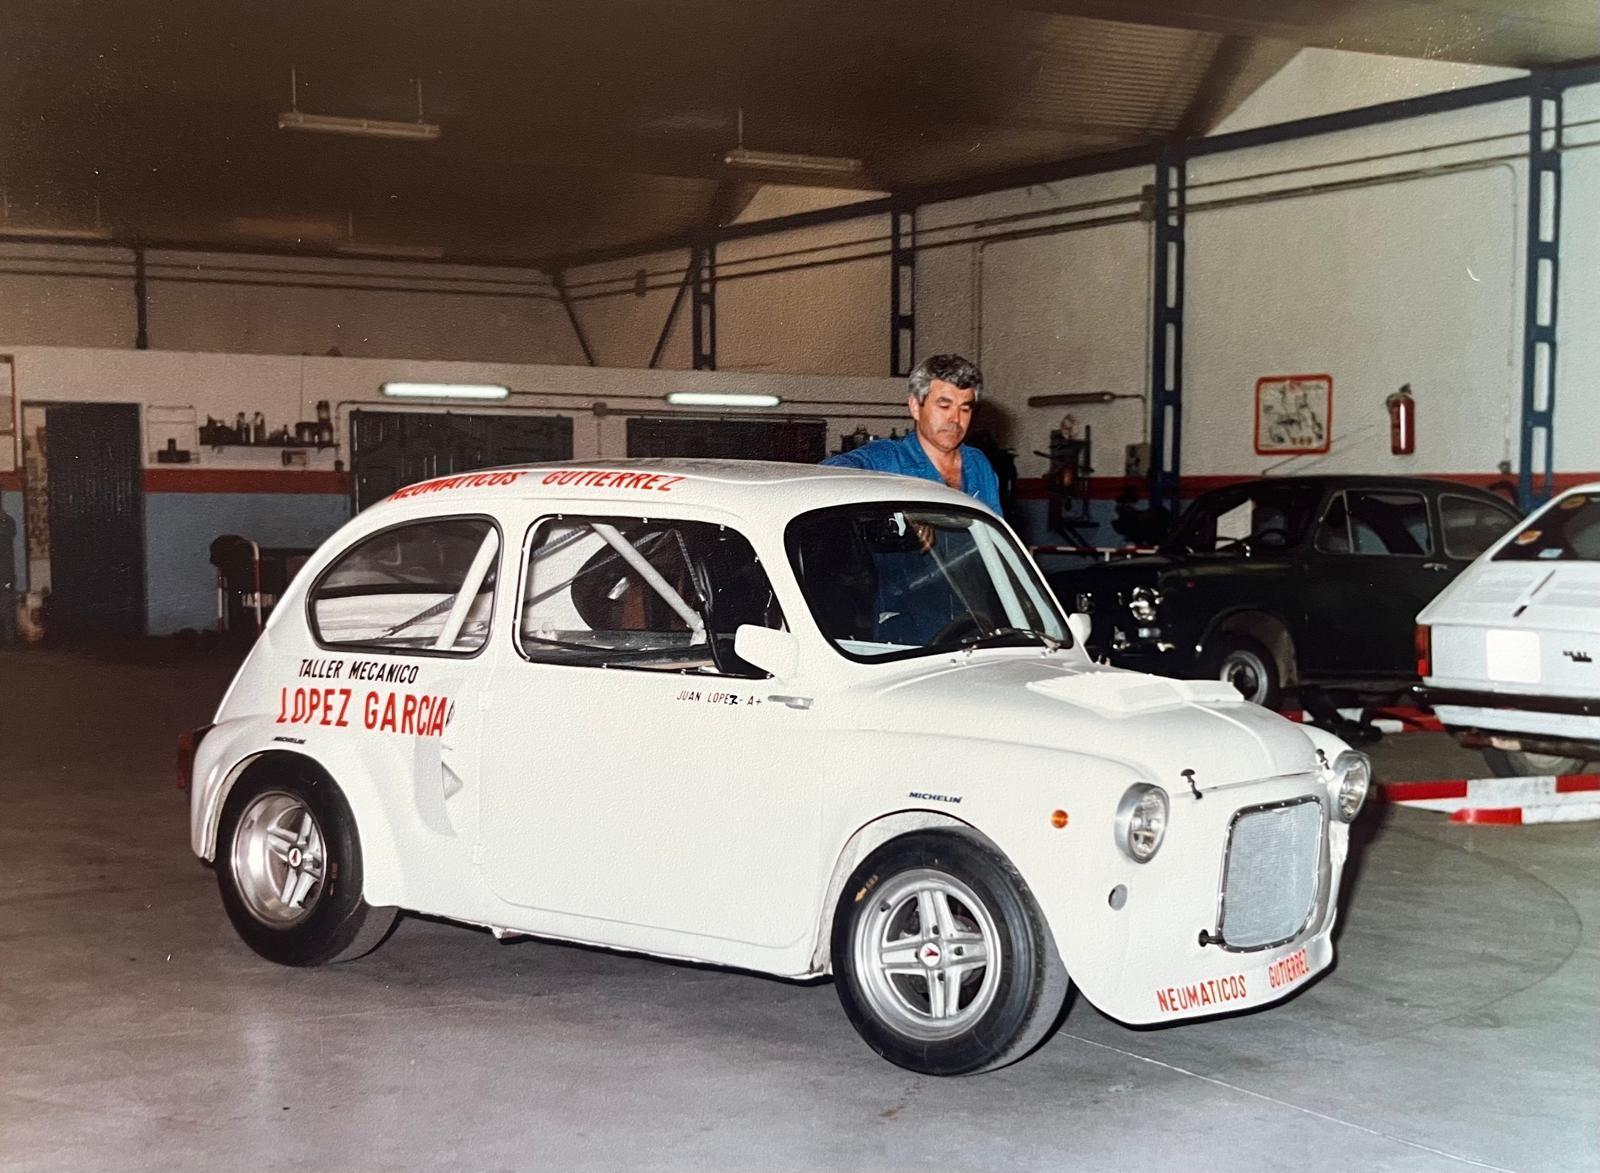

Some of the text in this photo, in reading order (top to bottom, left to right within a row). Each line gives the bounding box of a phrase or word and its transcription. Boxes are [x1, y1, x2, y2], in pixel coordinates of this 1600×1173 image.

[387, 471, 686, 502] NEUMATICOS GUTIERREZ
[299, 659, 419, 684] TALLER MECANICO
[676, 690, 701, 701] JUAN
[276, 688, 352, 727] LOPEZ
[364, 691, 448, 736] GARCIA
[909, 792, 962, 803] MICHELIN
[1156, 949, 1310, 1012] NEUMATICOS GUTIERREZ
